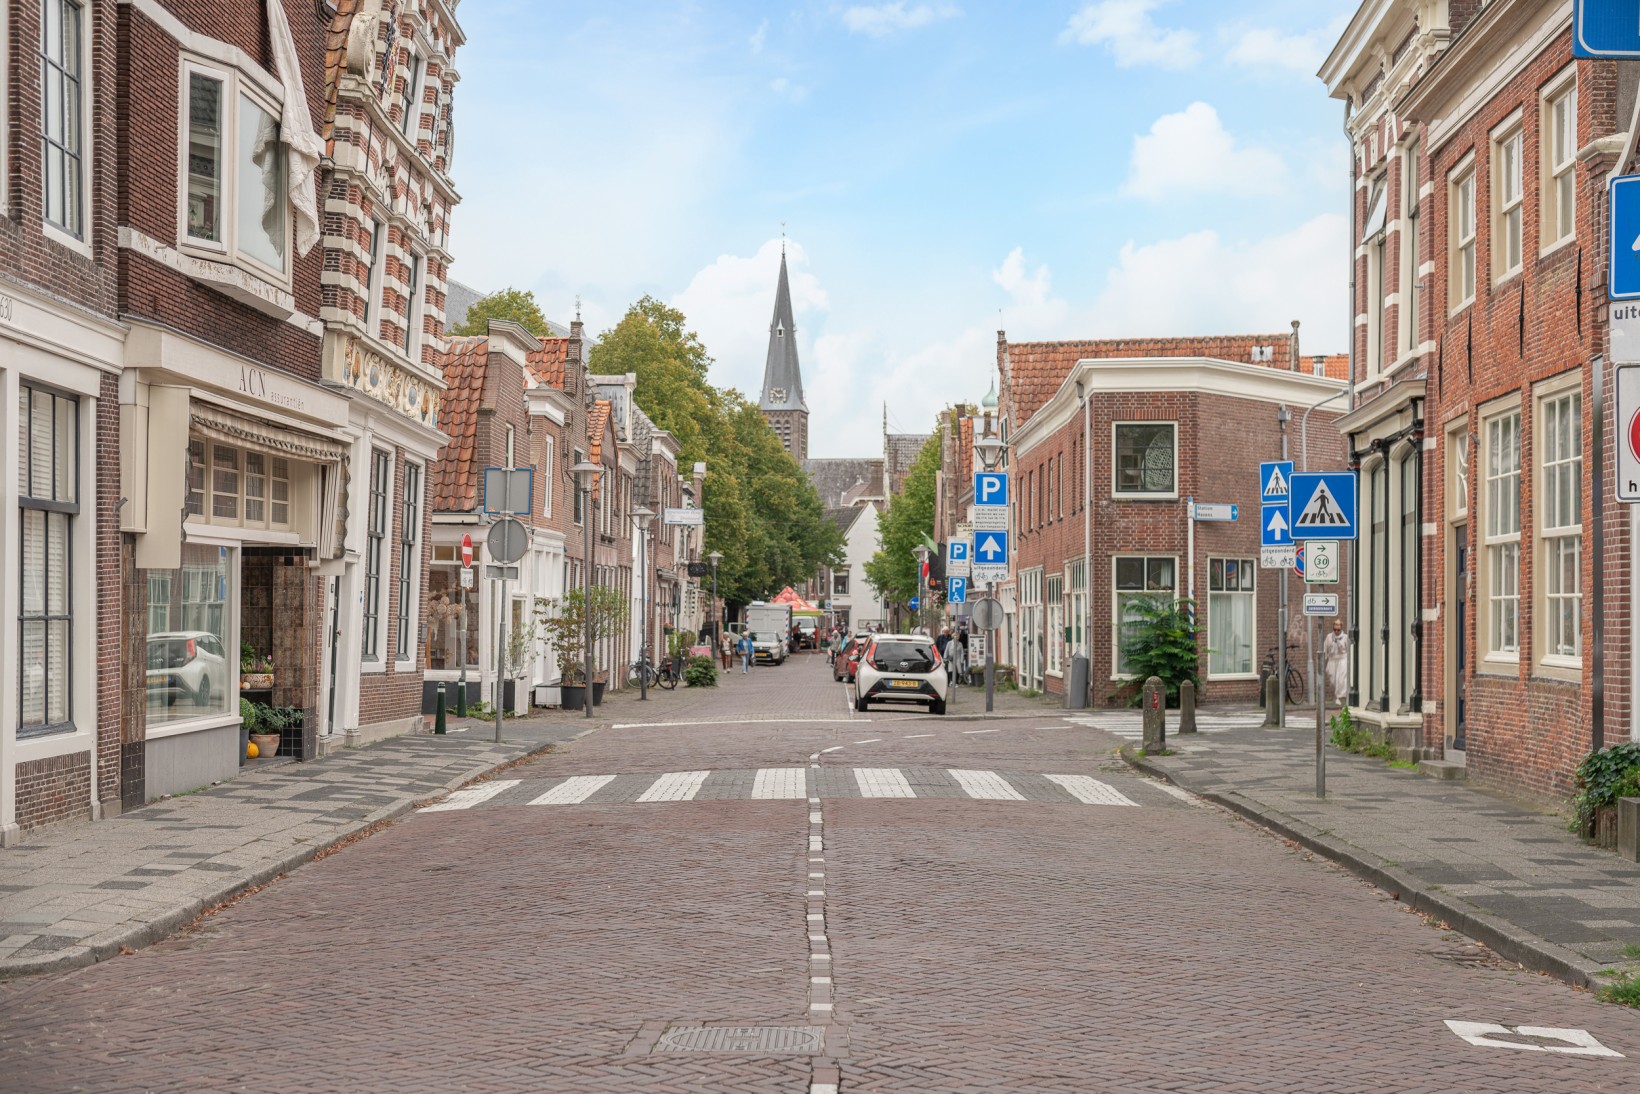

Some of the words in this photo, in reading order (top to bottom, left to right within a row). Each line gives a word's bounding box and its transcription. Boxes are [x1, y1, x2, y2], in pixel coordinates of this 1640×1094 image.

[1614, 305, 1640, 320] uit
[239, 365, 266, 398] ACN
[982, 476, 1001, 502] P
[953, 544, 964, 558] P
[1316, 558, 1328, 566] 30
[952, 579, 963, 592] P
